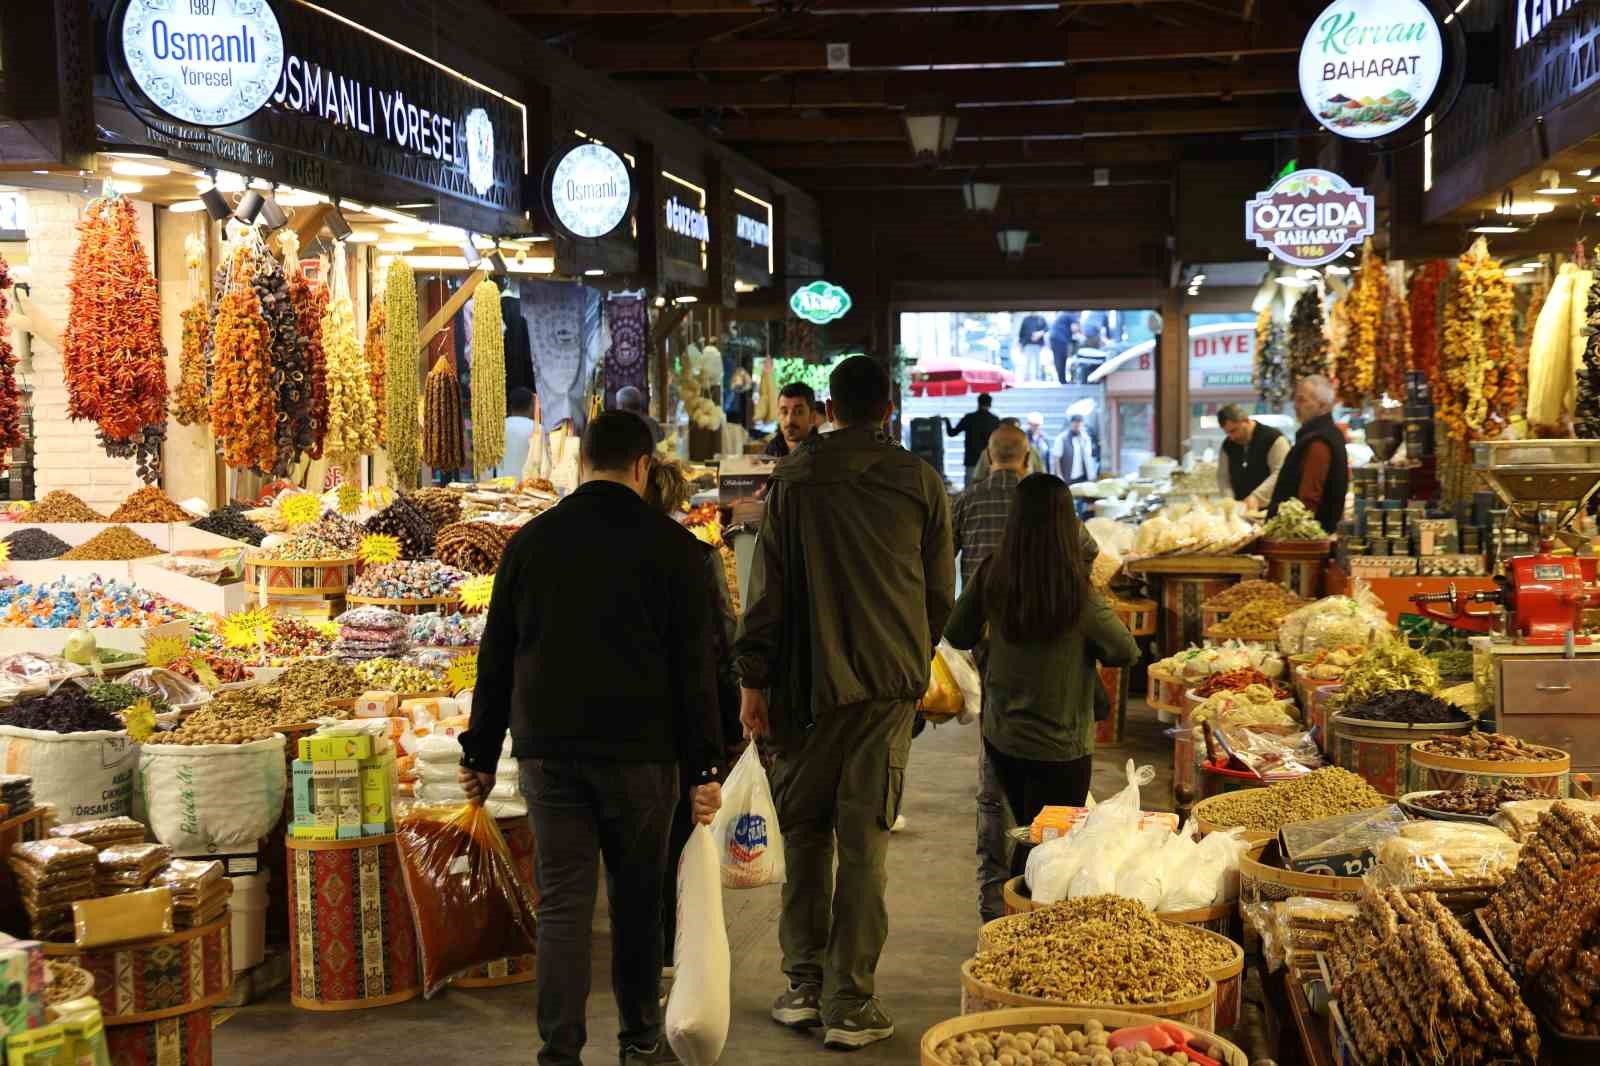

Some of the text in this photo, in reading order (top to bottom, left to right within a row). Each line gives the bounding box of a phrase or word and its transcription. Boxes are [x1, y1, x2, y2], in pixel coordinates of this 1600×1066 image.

[152, 20, 256, 63] Osmanlı
[1317, 11, 1426, 54] Kervan
[1323, 56, 1420, 80] BAHARAT
[379, 89, 464, 164] YÖRESEL
[566, 176, 617, 201] Osmanlı
[1255, 199, 1364, 229] ÖZGIDA
[1274, 228, 1348, 246] BAHARAT
